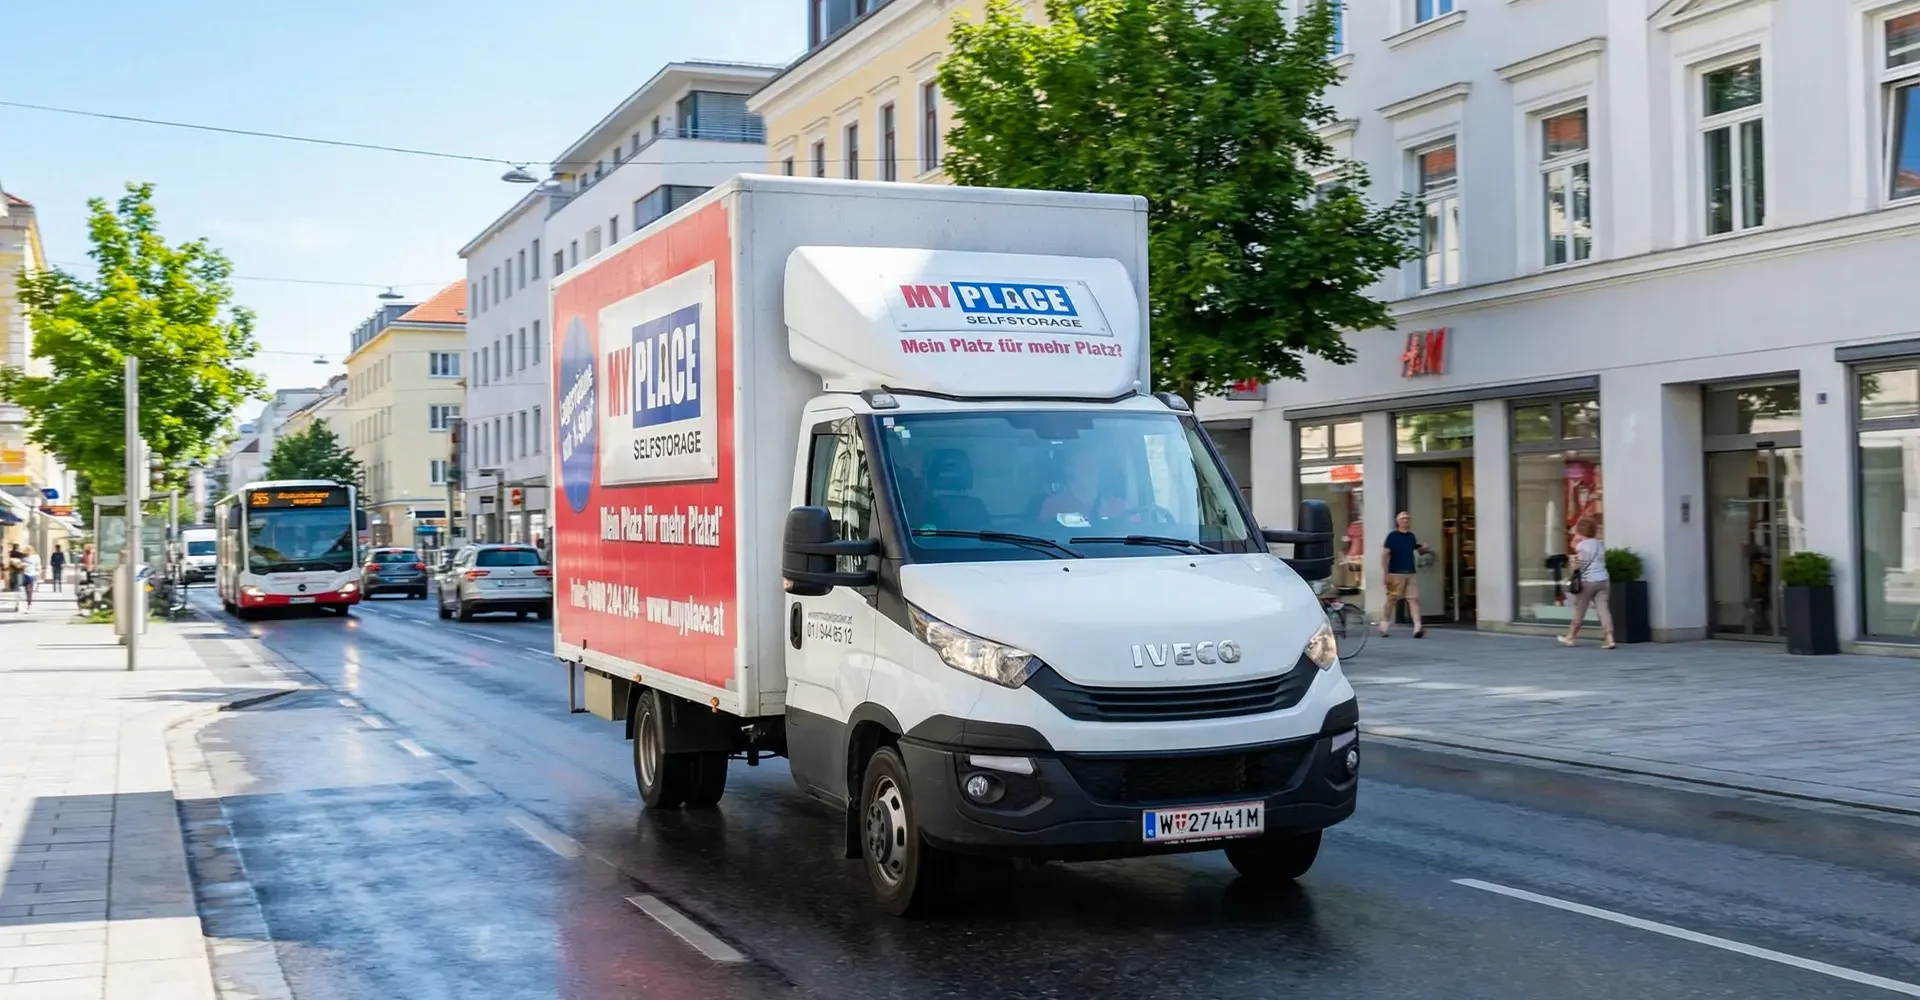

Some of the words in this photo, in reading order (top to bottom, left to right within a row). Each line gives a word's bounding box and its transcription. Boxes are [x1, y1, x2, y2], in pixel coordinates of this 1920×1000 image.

[900, 285, 951, 308] MY
[957, 286, 1070, 312] PLACE
[966, 316, 1083, 328] SELFSTORAGE
[901, 339, 946, 354] Mein
[950, 338, 995, 353] Platz
[998, 339, 1023, 353] für
[1028, 340, 1071, 354] mehr
[608, 346, 631, 418] MY
[635, 323, 697, 412] PLACE
[633, 430, 701, 460] SELFSTORAGE
[660, 505, 686, 544] mehr
[646, 594, 724, 636] www.myplace.at
[1131, 639, 1241, 668] IVECO
